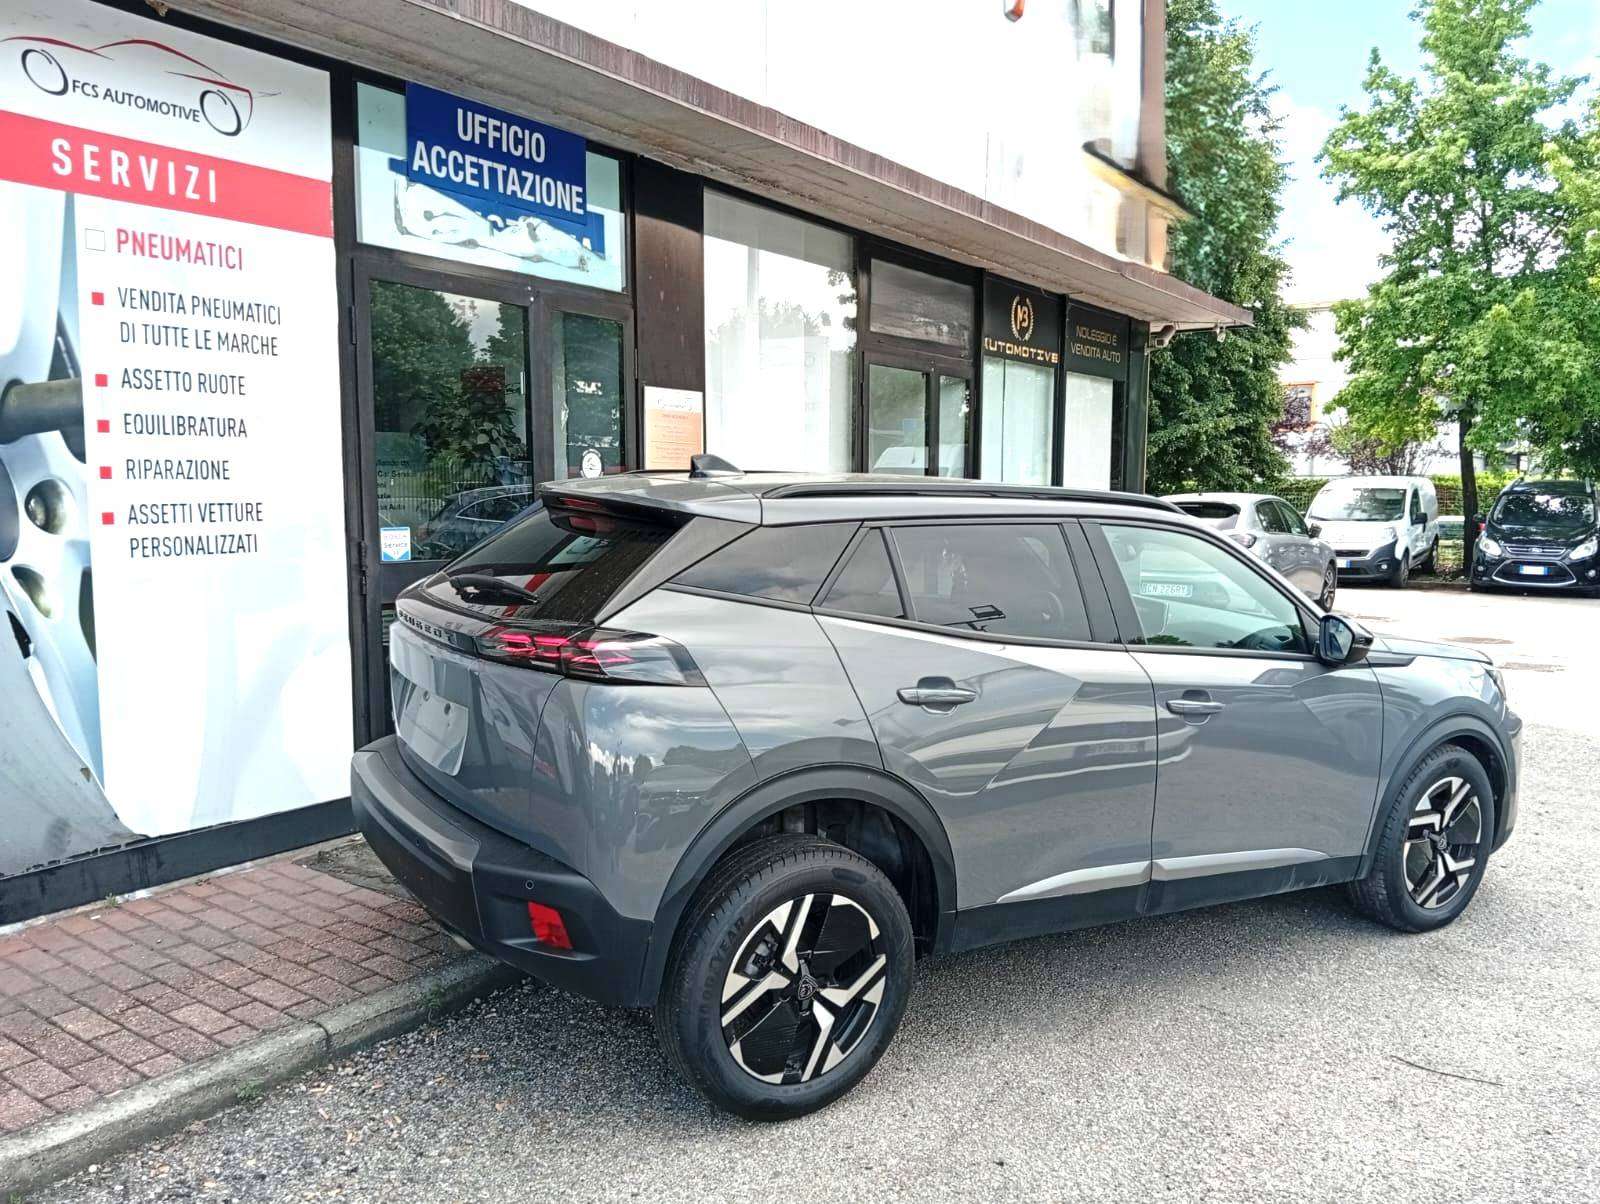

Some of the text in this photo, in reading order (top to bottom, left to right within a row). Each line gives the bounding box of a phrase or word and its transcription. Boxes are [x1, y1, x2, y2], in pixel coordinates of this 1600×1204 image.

[72, 79, 200, 123] FCS AUTOMOTIVE
[457, 108, 546, 163] UFFICIO
[51, 138, 216, 203] SERVIZI
[412, 140, 584, 216] ACCETTAZIONE
[116, 228, 243, 271] PNEUMATICI
[117, 286, 281, 326] VENDITA PNEUMATICI
[120, 322, 278, 357] DI TUTTE LE MARCHE
[1070, 342, 1120, 364] VENDITA AUTO
[1112, 335, 1118, 347] E
[121, 367, 246, 396] ASSETTO RUOTE
[124, 413, 248, 438] EQUILIBRATURA
[126, 459, 231, 481] RIPARAZIONE
[128, 502, 264, 525] ASSETTI VETTURE
[129, 533, 259, 559] PERSONALIZZATI
